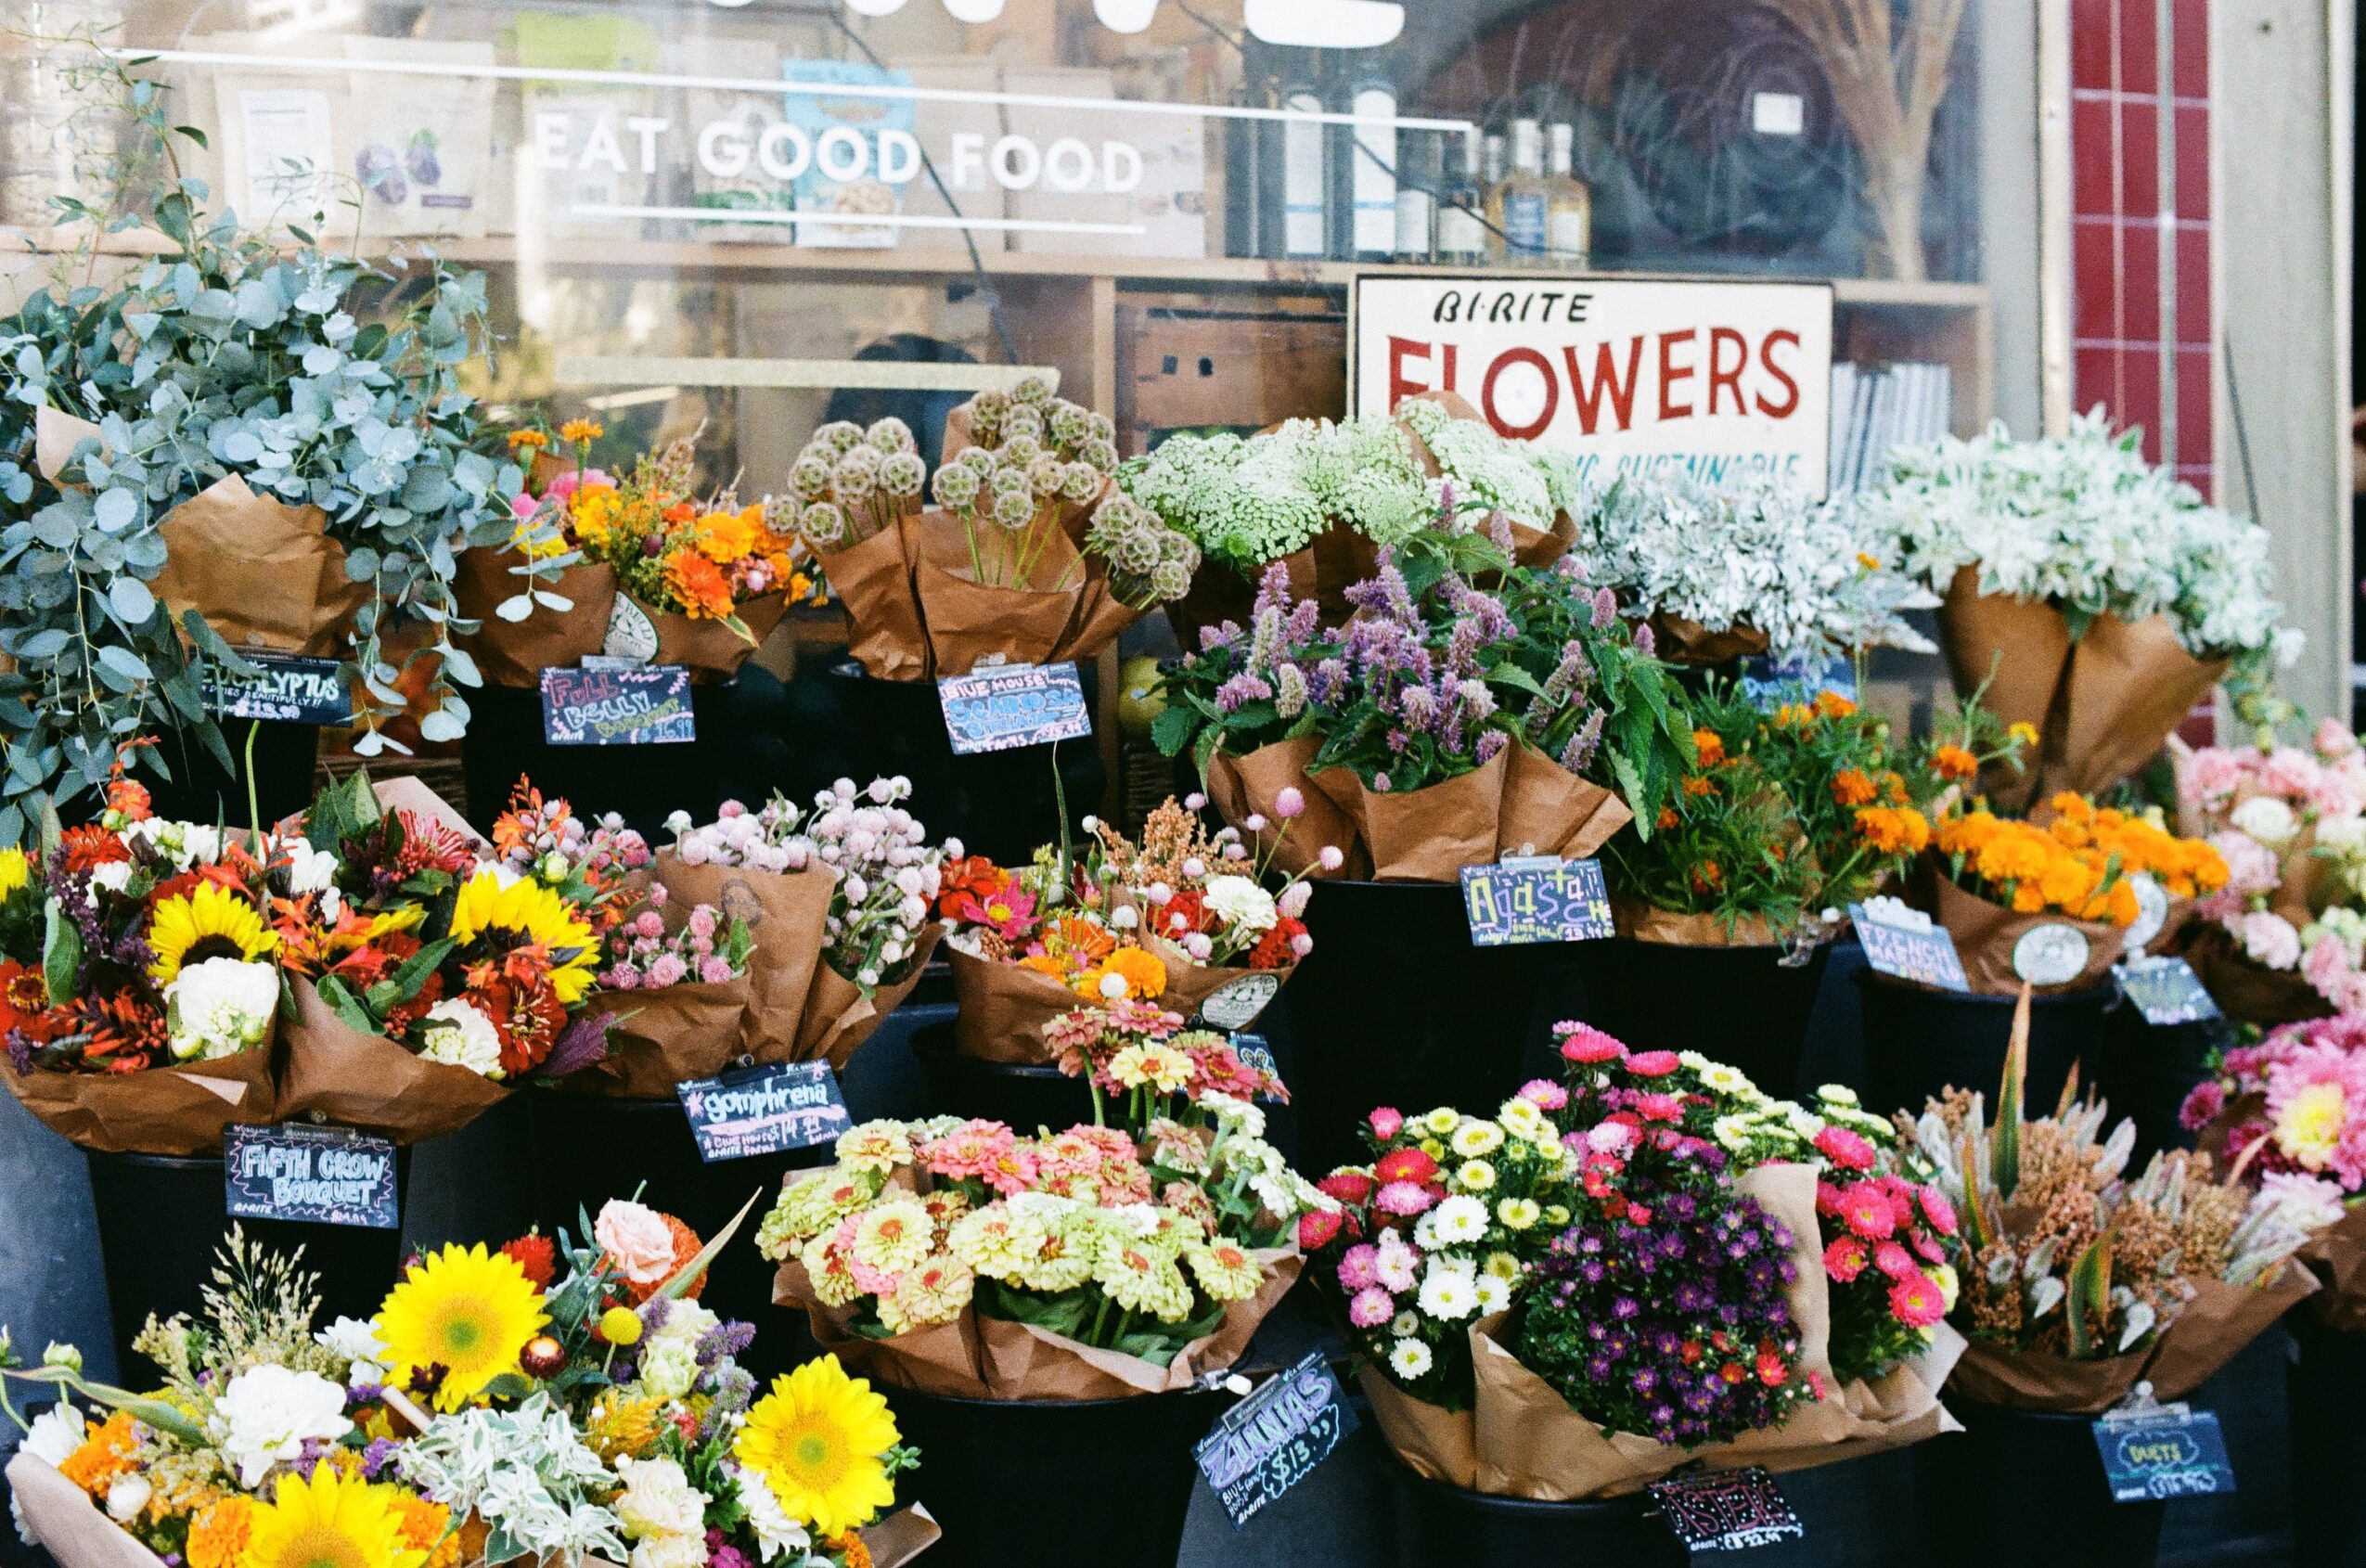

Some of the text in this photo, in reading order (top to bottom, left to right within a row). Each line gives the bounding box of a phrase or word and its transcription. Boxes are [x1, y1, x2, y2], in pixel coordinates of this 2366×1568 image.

[533, 112, 1143, 194] EAT GOOD FOOD
[1617, 453, 1801, 485] SUSAINBE
[703, 1076, 829, 1124] gomphrena
[241, 1144, 388, 1182] FIFTH CROW
[272, 1176, 378, 1207] BOUQUET
[1198, 1368, 1333, 1490] ZINNIAS
